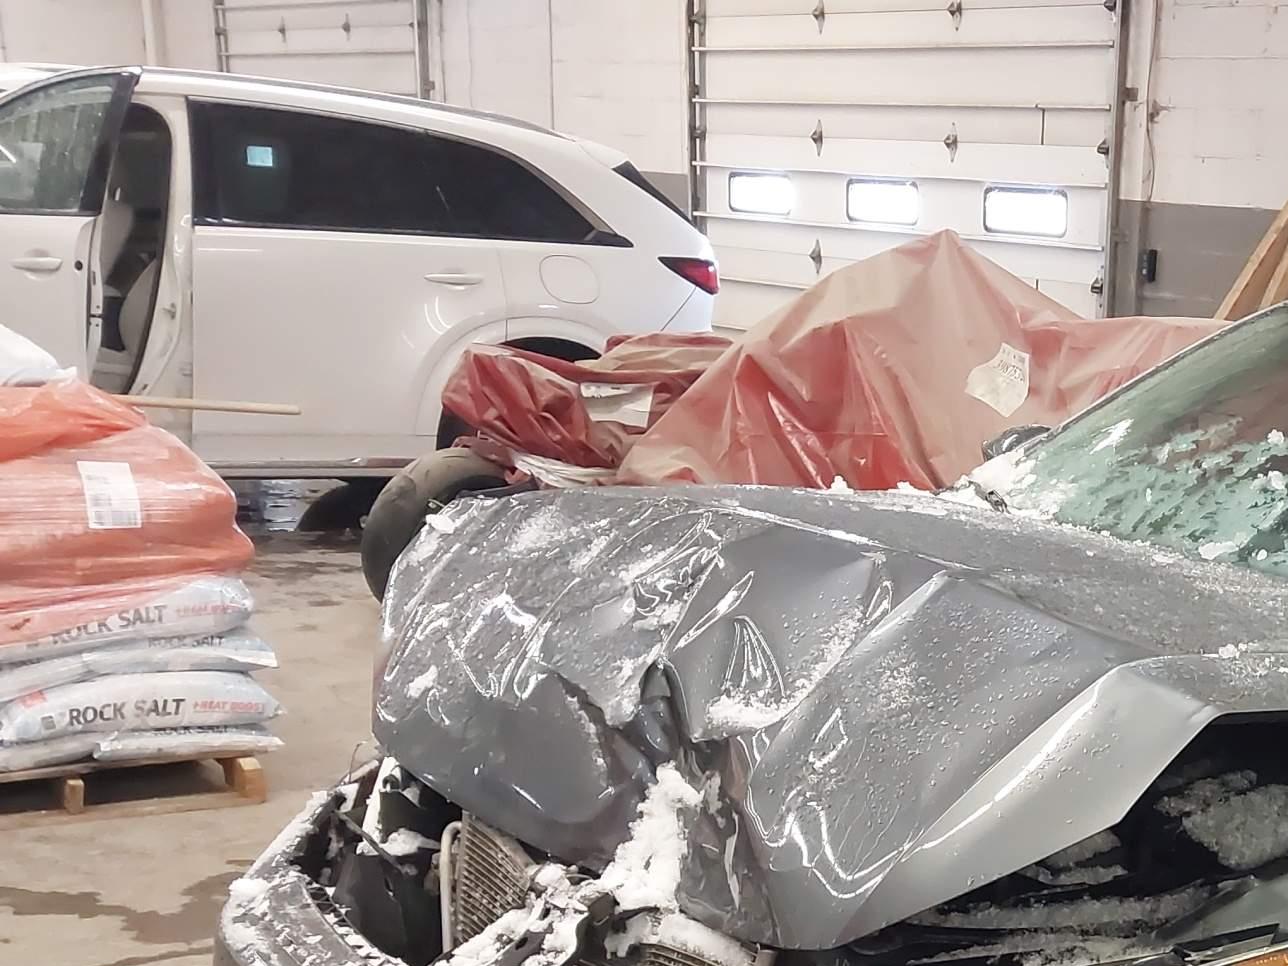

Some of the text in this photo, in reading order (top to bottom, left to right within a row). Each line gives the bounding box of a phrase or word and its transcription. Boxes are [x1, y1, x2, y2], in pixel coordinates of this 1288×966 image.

[118, 604, 168, 630] SALT
[68, 701, 127, 727] ROCK
[133, 698, 186, 719] SALT
